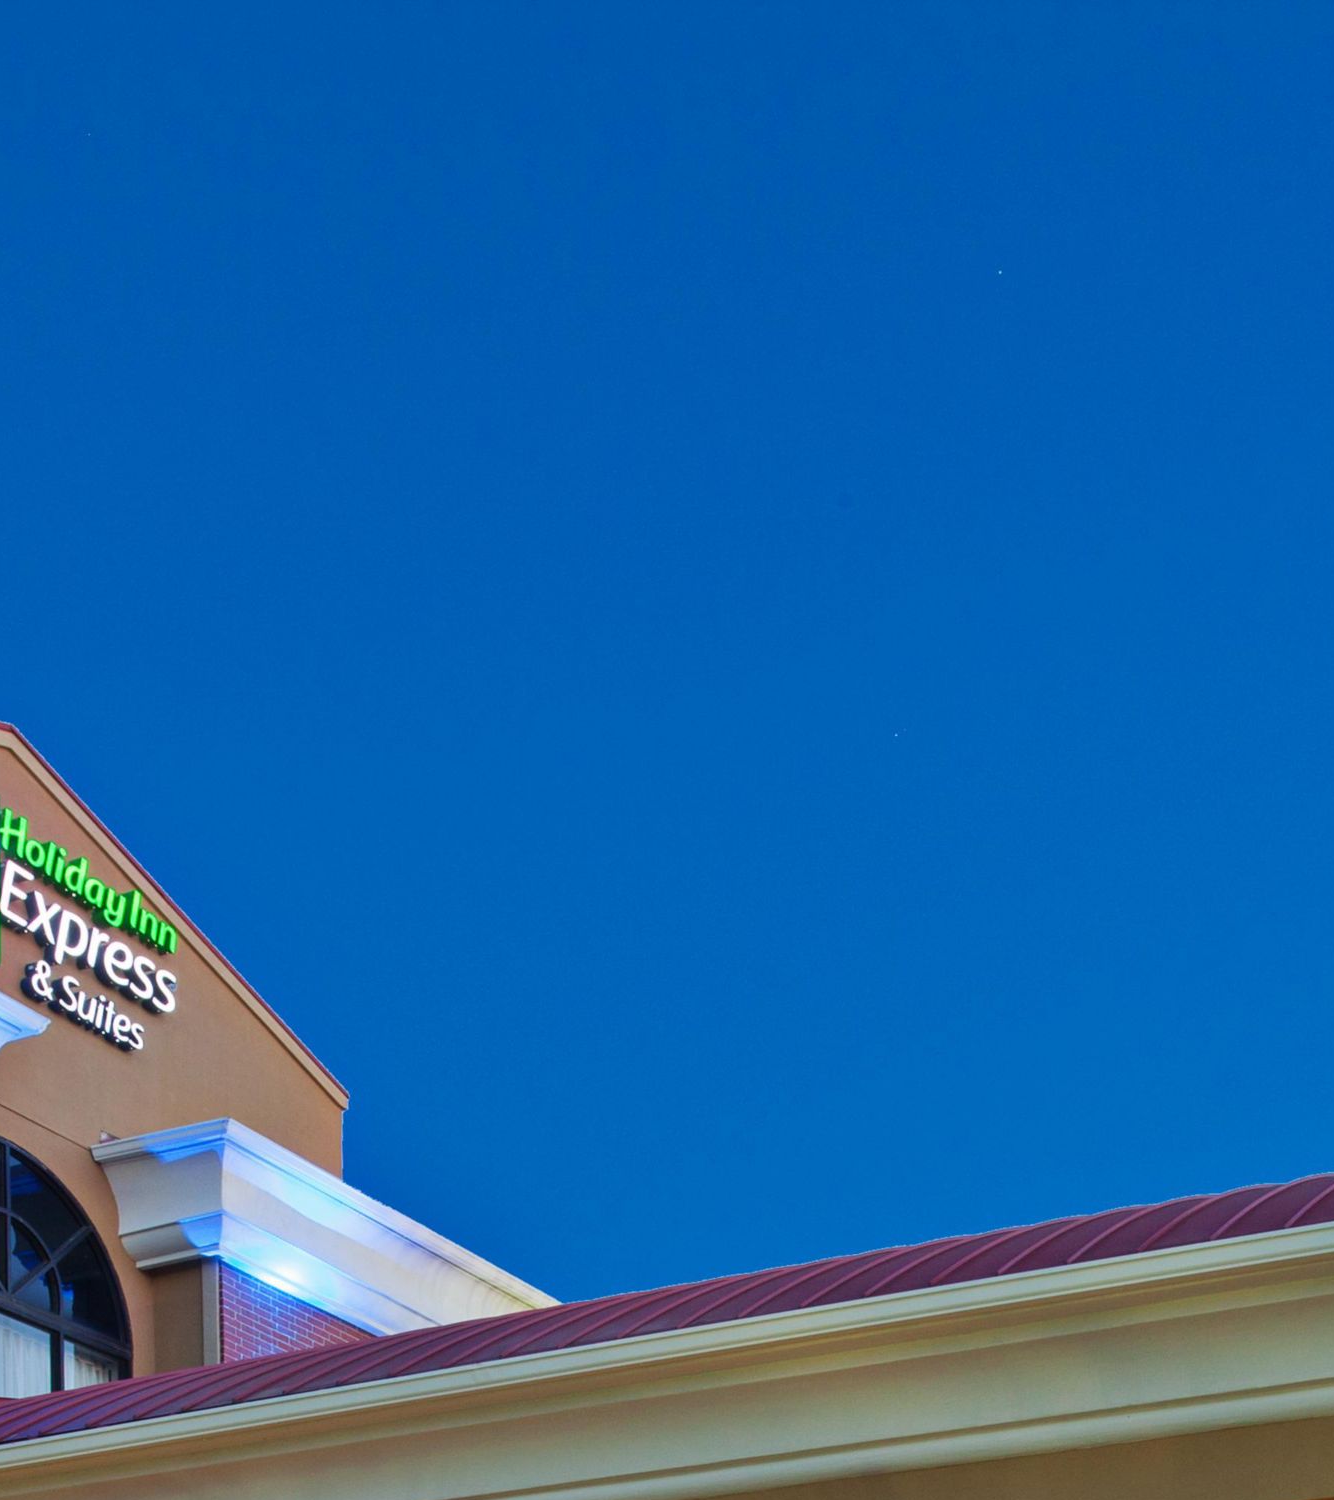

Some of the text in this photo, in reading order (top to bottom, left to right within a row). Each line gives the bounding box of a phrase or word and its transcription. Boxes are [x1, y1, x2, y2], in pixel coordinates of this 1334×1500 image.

[0, 808, 178, 953] Holiday Inn
[0, 859, 177, 1013] Express
[31, 960, 145, 1050] & Suites
